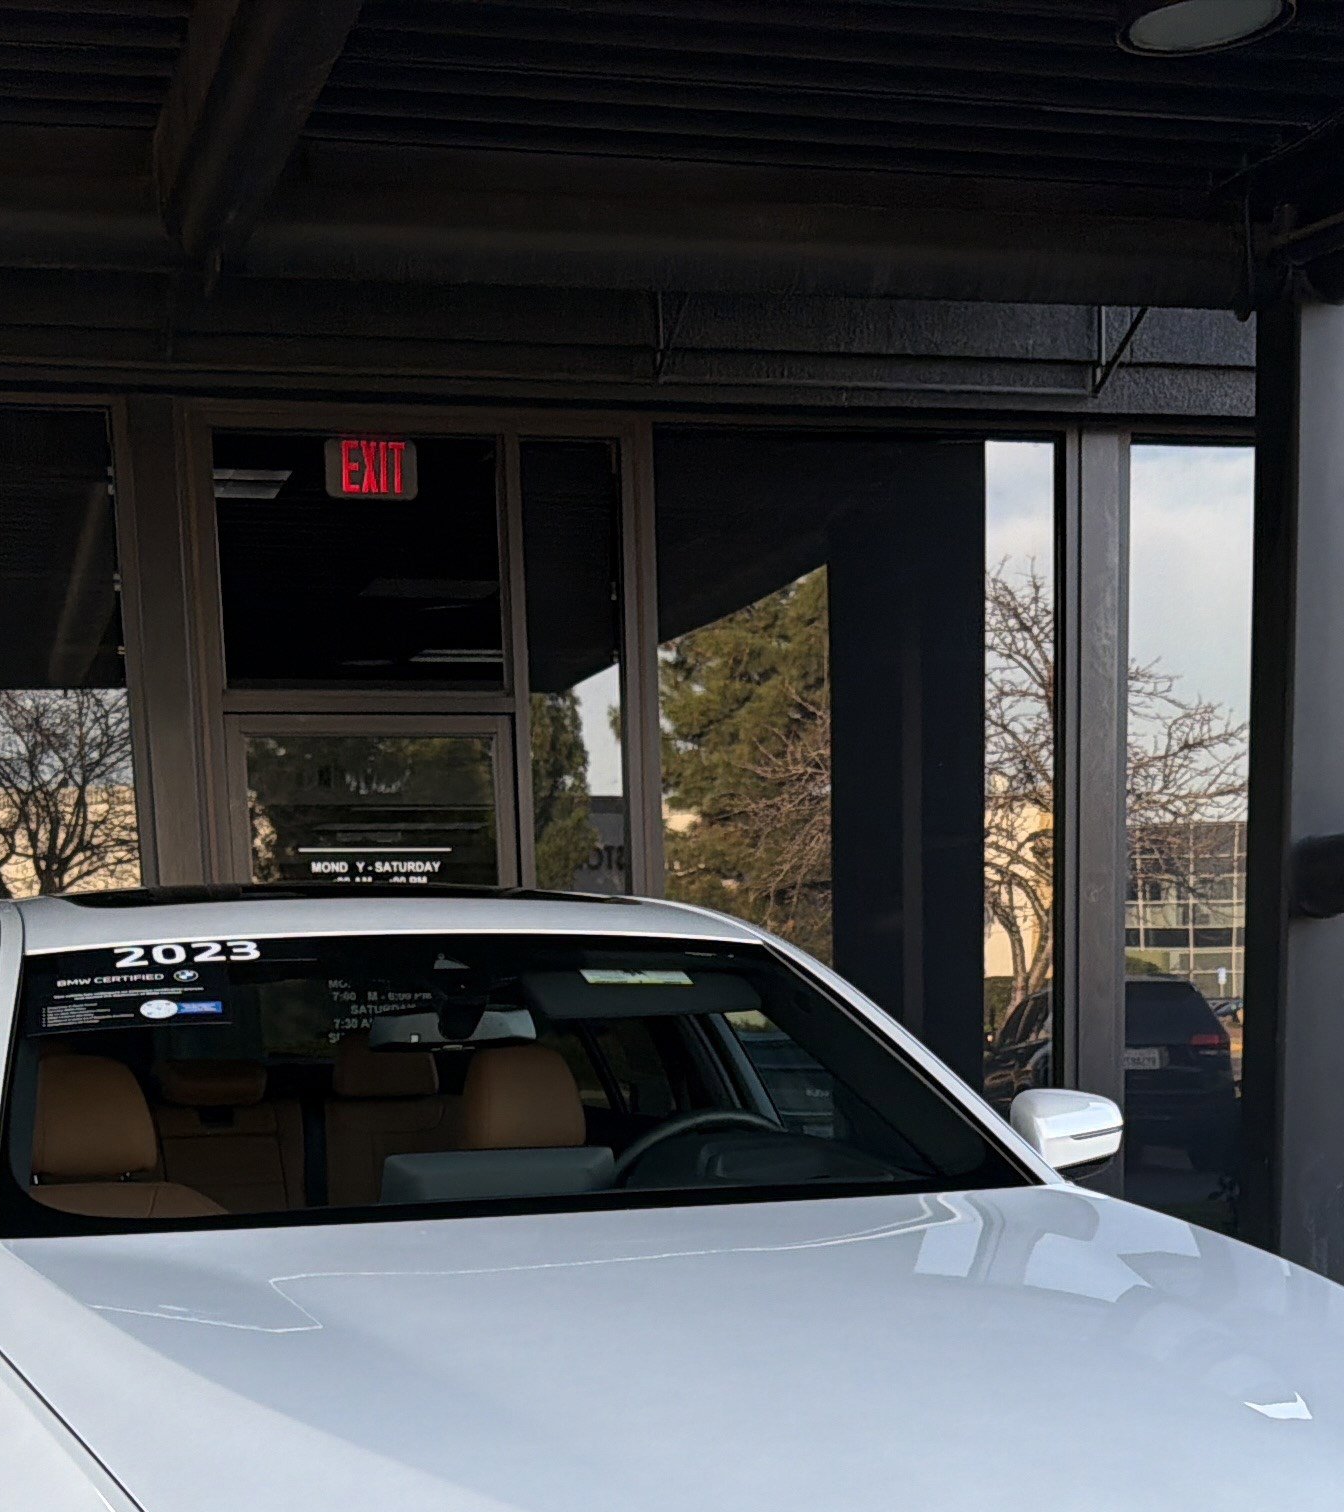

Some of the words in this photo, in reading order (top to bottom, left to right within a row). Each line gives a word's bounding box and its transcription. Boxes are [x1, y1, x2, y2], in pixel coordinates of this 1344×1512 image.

[342, 440, 405, 493] EXIT
[374, 861, 441, 873] SATURDAY
[113, 941, 260, 968] 2023
[56, 977, 91, 988] BMW
[93, 973, 165, 985] CERTIFIED
